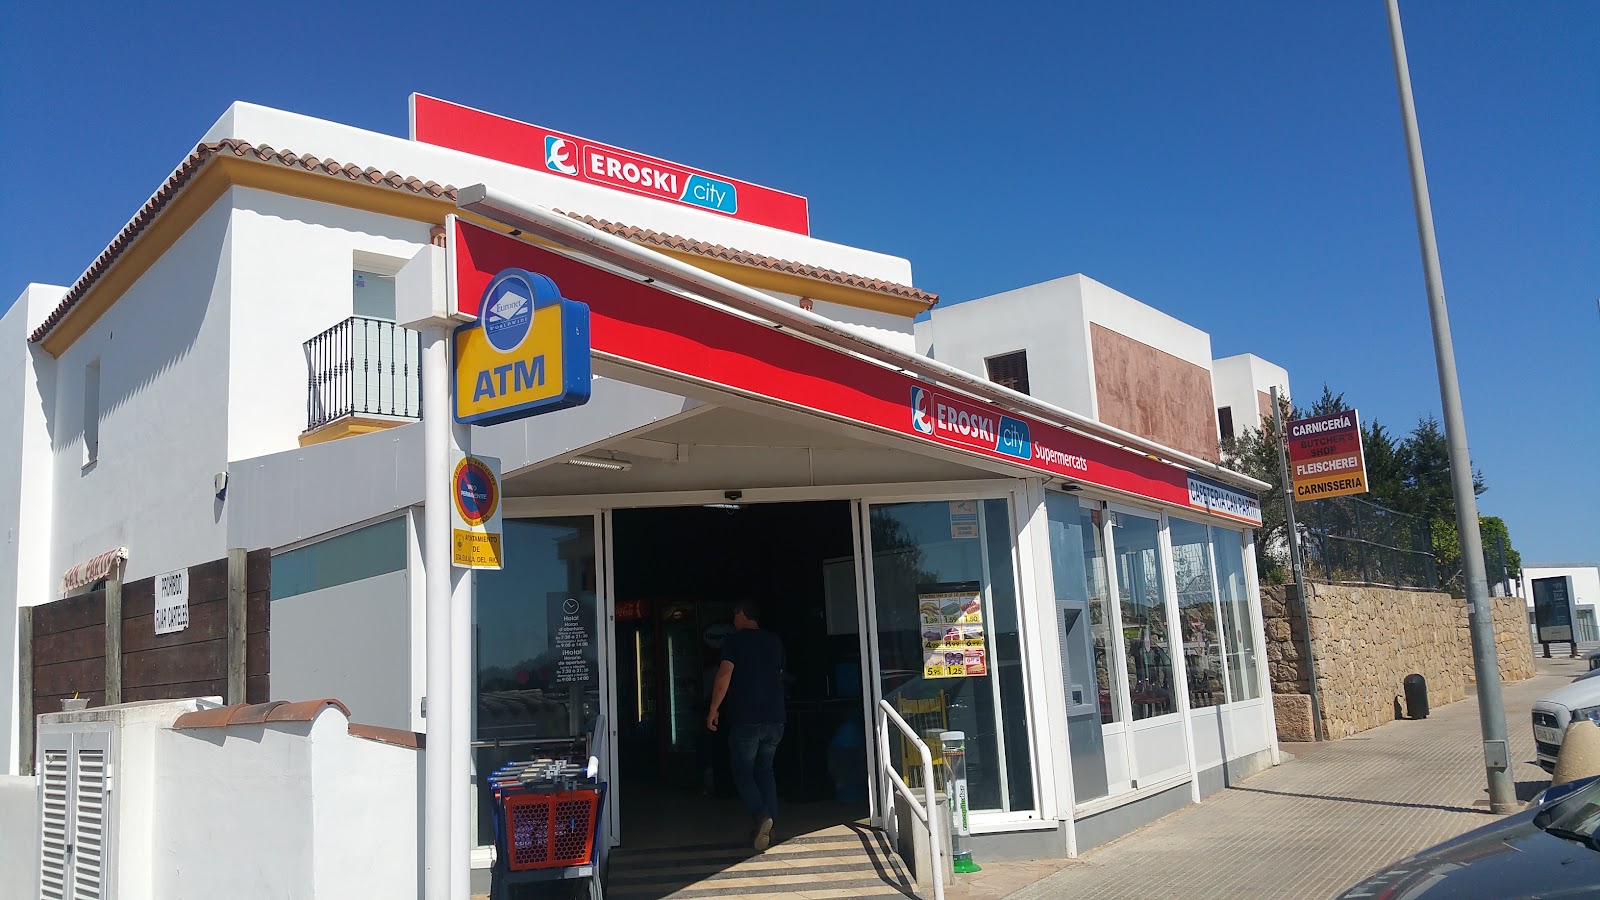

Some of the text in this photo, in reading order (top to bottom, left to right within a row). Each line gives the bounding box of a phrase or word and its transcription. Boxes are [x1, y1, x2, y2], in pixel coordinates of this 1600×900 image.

[590, 152, 726, 208] EROSKI city
[496, 300, 521, 313] Euronet
[472, 354, 545, 403] ATM
[1292, 415, 1352, 437] CARNICERÍA
[937, 403, 1088, 471] EROSKI city Supermercats
[1300, 432, 1354, 449] BUTCHER'S
[1310, 445, 1336, 457] SHOP
[1296, 456, 1358, 476] FLEISCHEREI
[1297, 477, 1363, 496] CARNISSERIA
